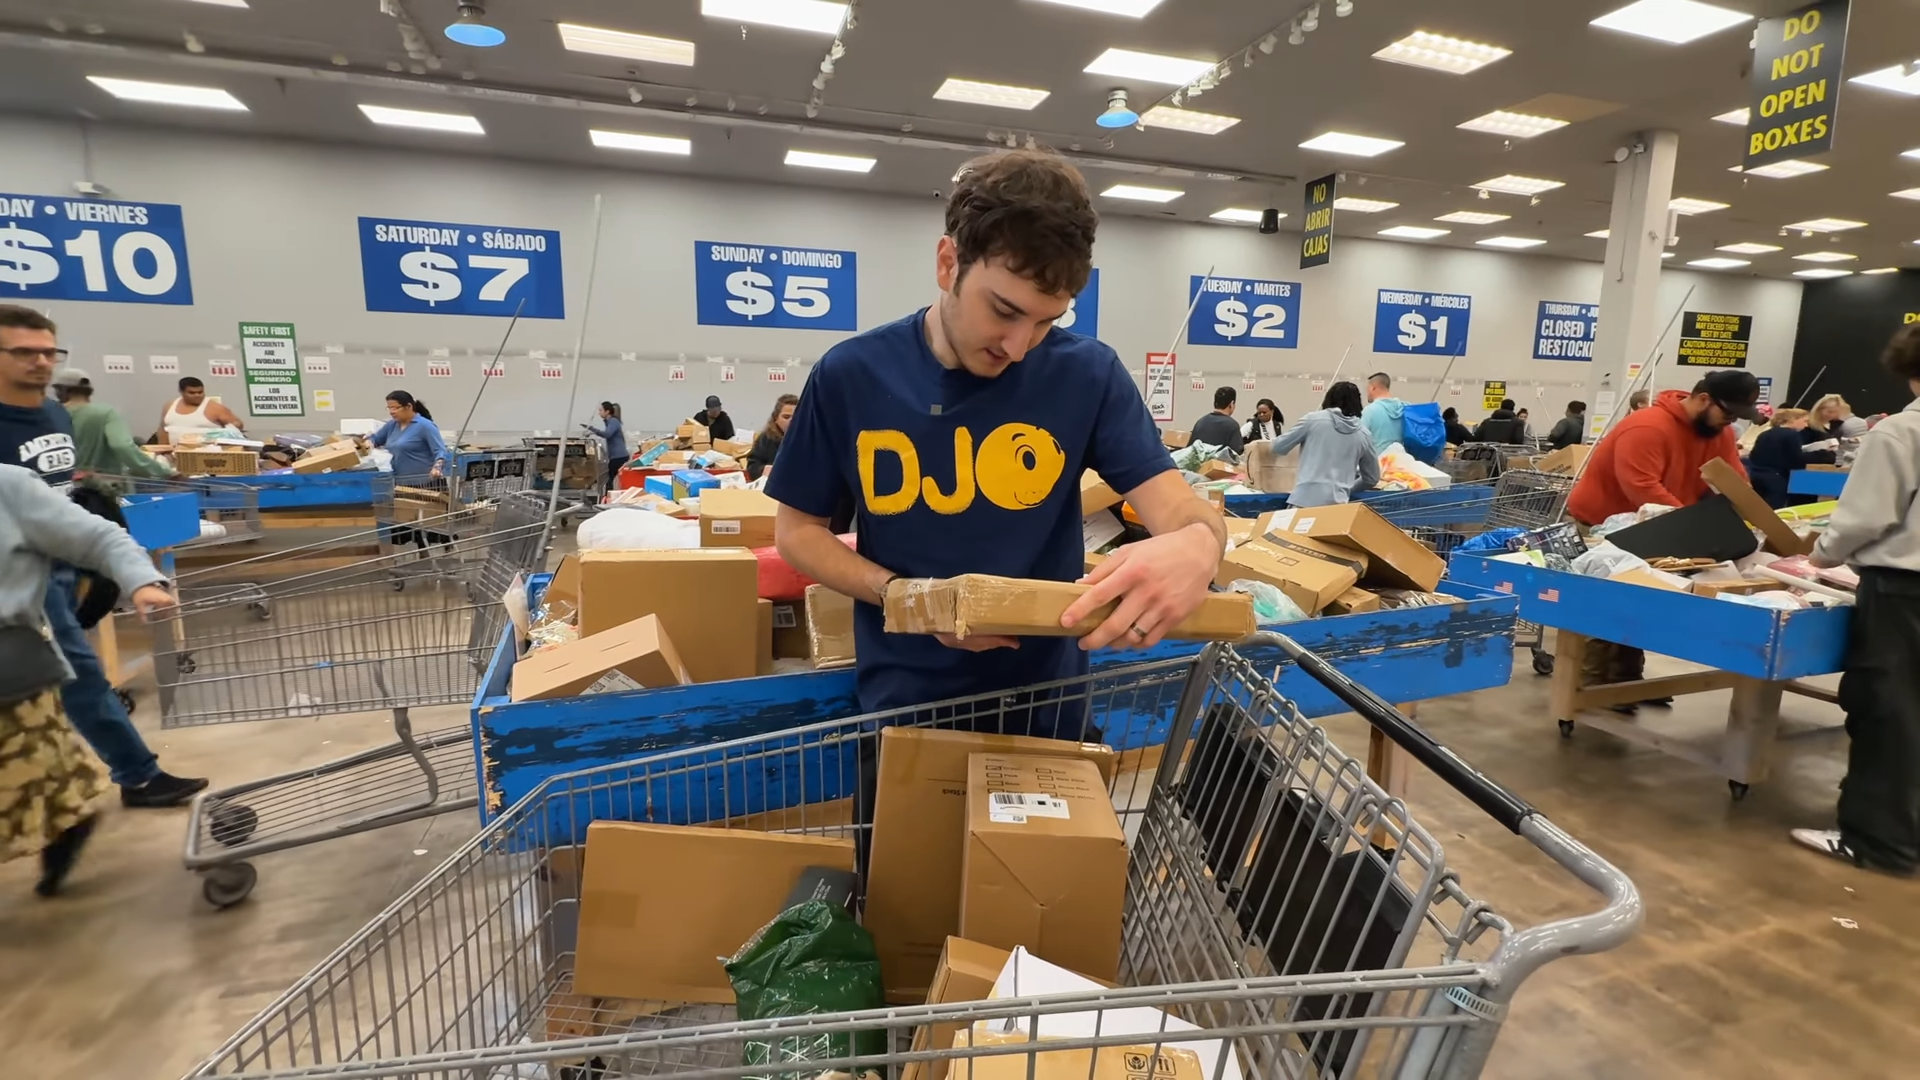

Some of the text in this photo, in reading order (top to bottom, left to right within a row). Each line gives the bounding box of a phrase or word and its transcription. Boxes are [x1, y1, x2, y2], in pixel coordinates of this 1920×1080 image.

[1782, 10, 1821, 42] DO
[1771, 43, 1825, 81] NOT
[1759, 79, 1826, 118] OPEN
[1749, 115, 1828, 156] BOXES
[1313, 183, 1327, 204] NO
[63, 202, 149, 225] VIERNES
[1305, 208, 1330, 232] ABRIR
[374, 224, 547, 252] SATURDAY SÁBADO
[1303, 233, 1329, 257] CAJAS
[0, 221, 177, 296] $10
[711, 245, 842, 269] SUNDAY DOMINGO
[399, 246, 530, 307] $7
[725, 266, 831, 321] $5
[1254, 282, 1291, 298] MARTES
[1380, 291, 1423, 306] WEDNESDAY
[1213, 295, 1287, 341] $2
[1545, 303, 1580, 316] THURSDAY
[1696, 314, 1711, 322] SOME
[1711, 315, 1725, 323] FOOD
[243, 326, 291, 336] SAFETY FIRST
[1397, 309, 1448, 351] $1
[1541, 319, 1585, 338] CLOSED
[1707, 323, 1725, 331] EXCEED
[1720, 331, 1732, 339] DATE
[1679, 348, 1714, 356] MERCHANDISE
[855, 422, 1067, 516] DJO
